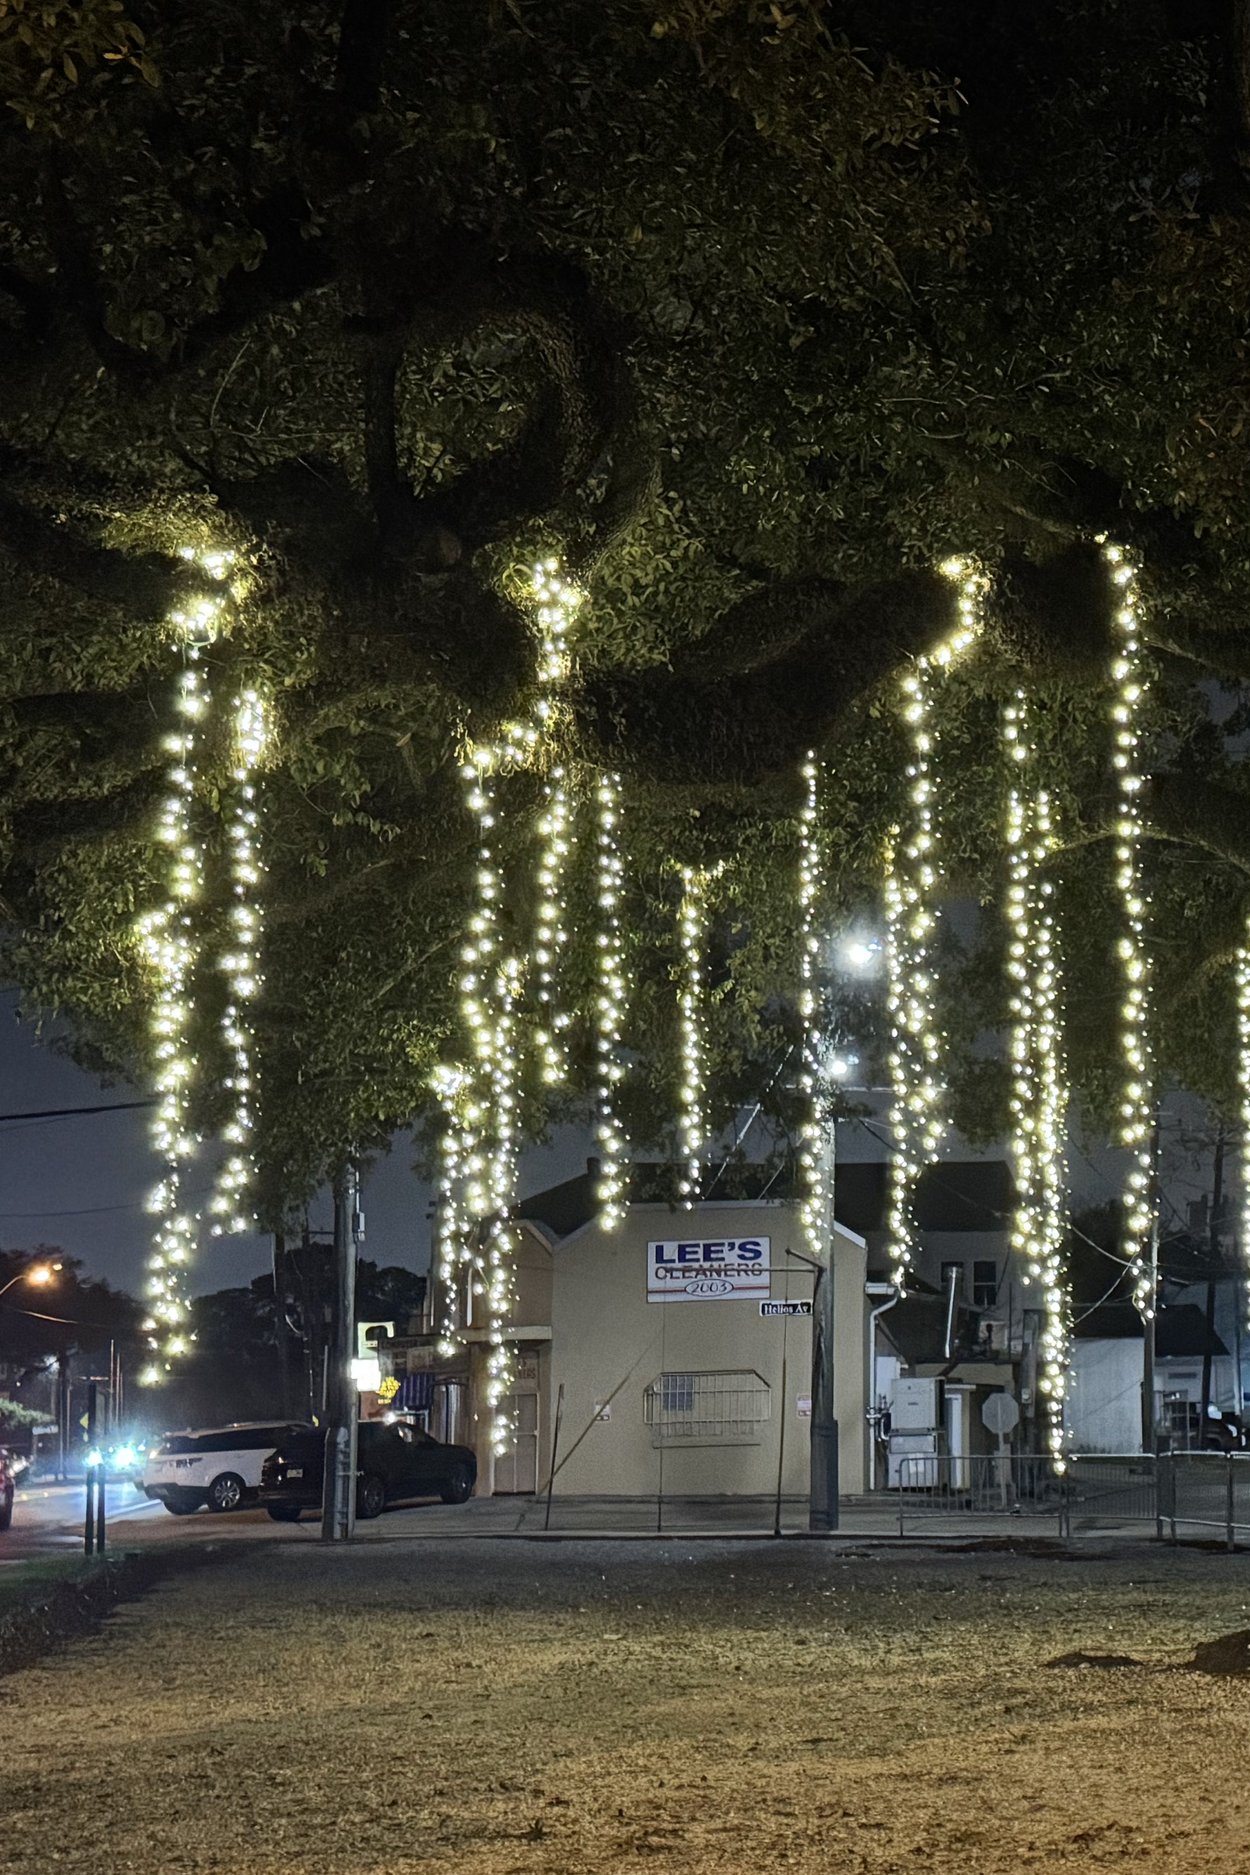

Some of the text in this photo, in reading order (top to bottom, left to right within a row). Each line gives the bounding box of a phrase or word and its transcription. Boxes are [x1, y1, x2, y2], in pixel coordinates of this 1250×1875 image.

[655, 1241, 764, 1264] LEE'S
[655, 1263, 764, 1280] CLEANERS
[692, 1283, 728, 1294] 2003
